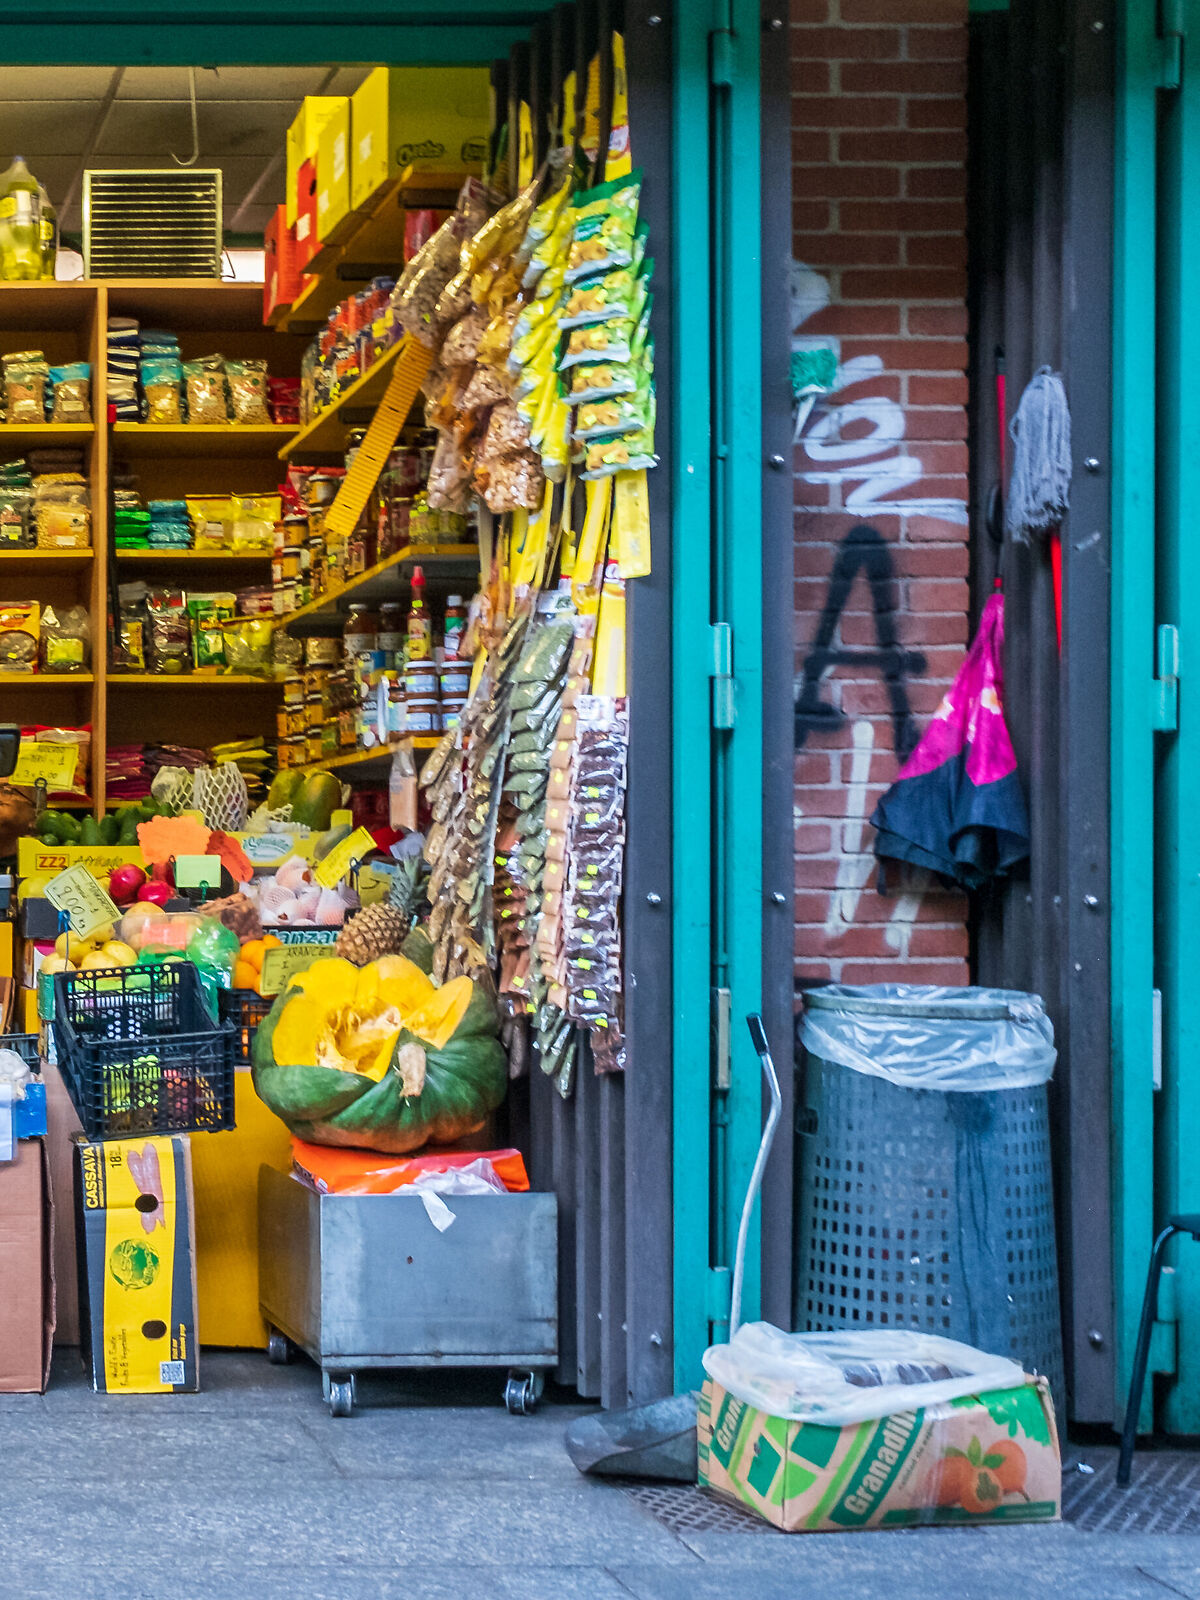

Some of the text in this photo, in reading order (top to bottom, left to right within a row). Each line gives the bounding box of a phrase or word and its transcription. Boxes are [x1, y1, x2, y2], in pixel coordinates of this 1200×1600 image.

[38, 856, 67, 868] ZZ2
[85, 1146, 99, 1209] CASSAVA
[110, 1155, 122, 1169] 18
[843, 1406, 918, 1515] Granadill
